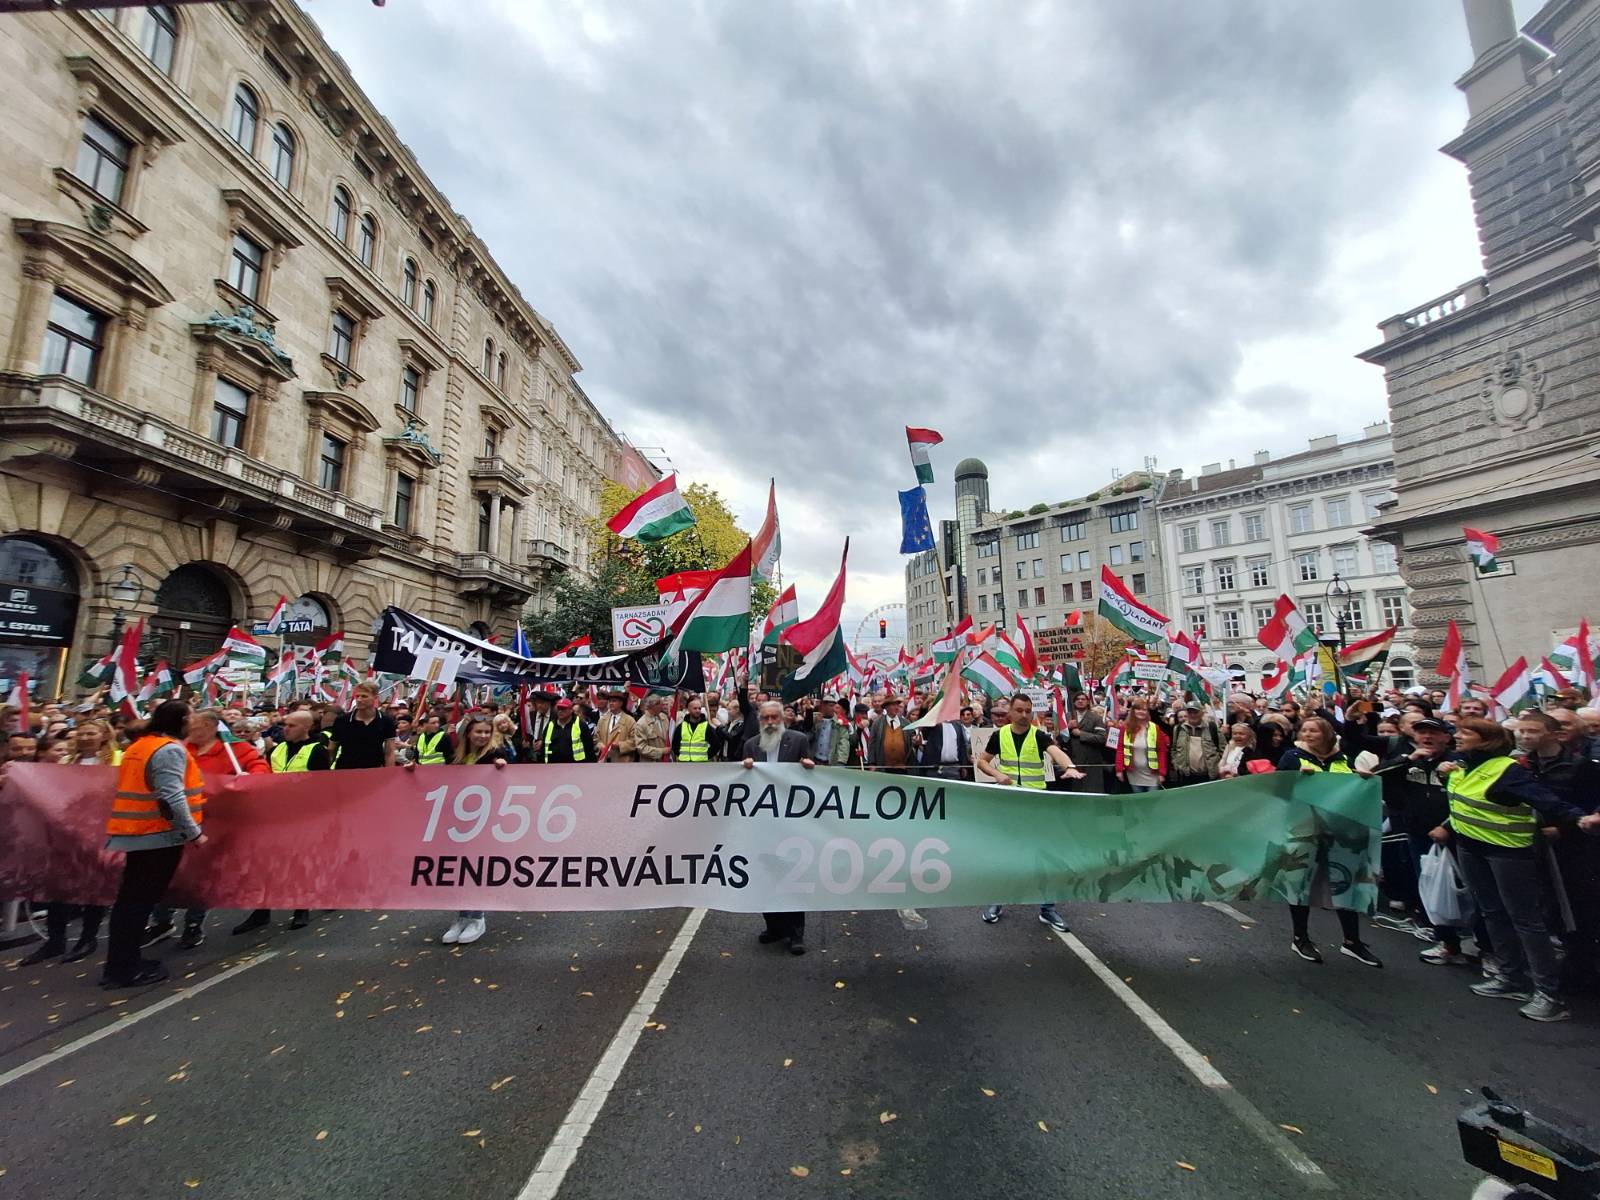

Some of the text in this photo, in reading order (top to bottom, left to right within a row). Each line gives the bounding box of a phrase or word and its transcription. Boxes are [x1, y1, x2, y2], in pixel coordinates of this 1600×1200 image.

[9, 622, 51, 632] ESTATE
[288, 621, 310, 633] TATA
[617, 639, 641, 647] TISZA
[1070, 643, 1085, 651] KELL
[422, 783, 946, 843] 1956 FORRADALOM
[410, 836, 952, 895] RENDSZERVÁLTÁS 2026
